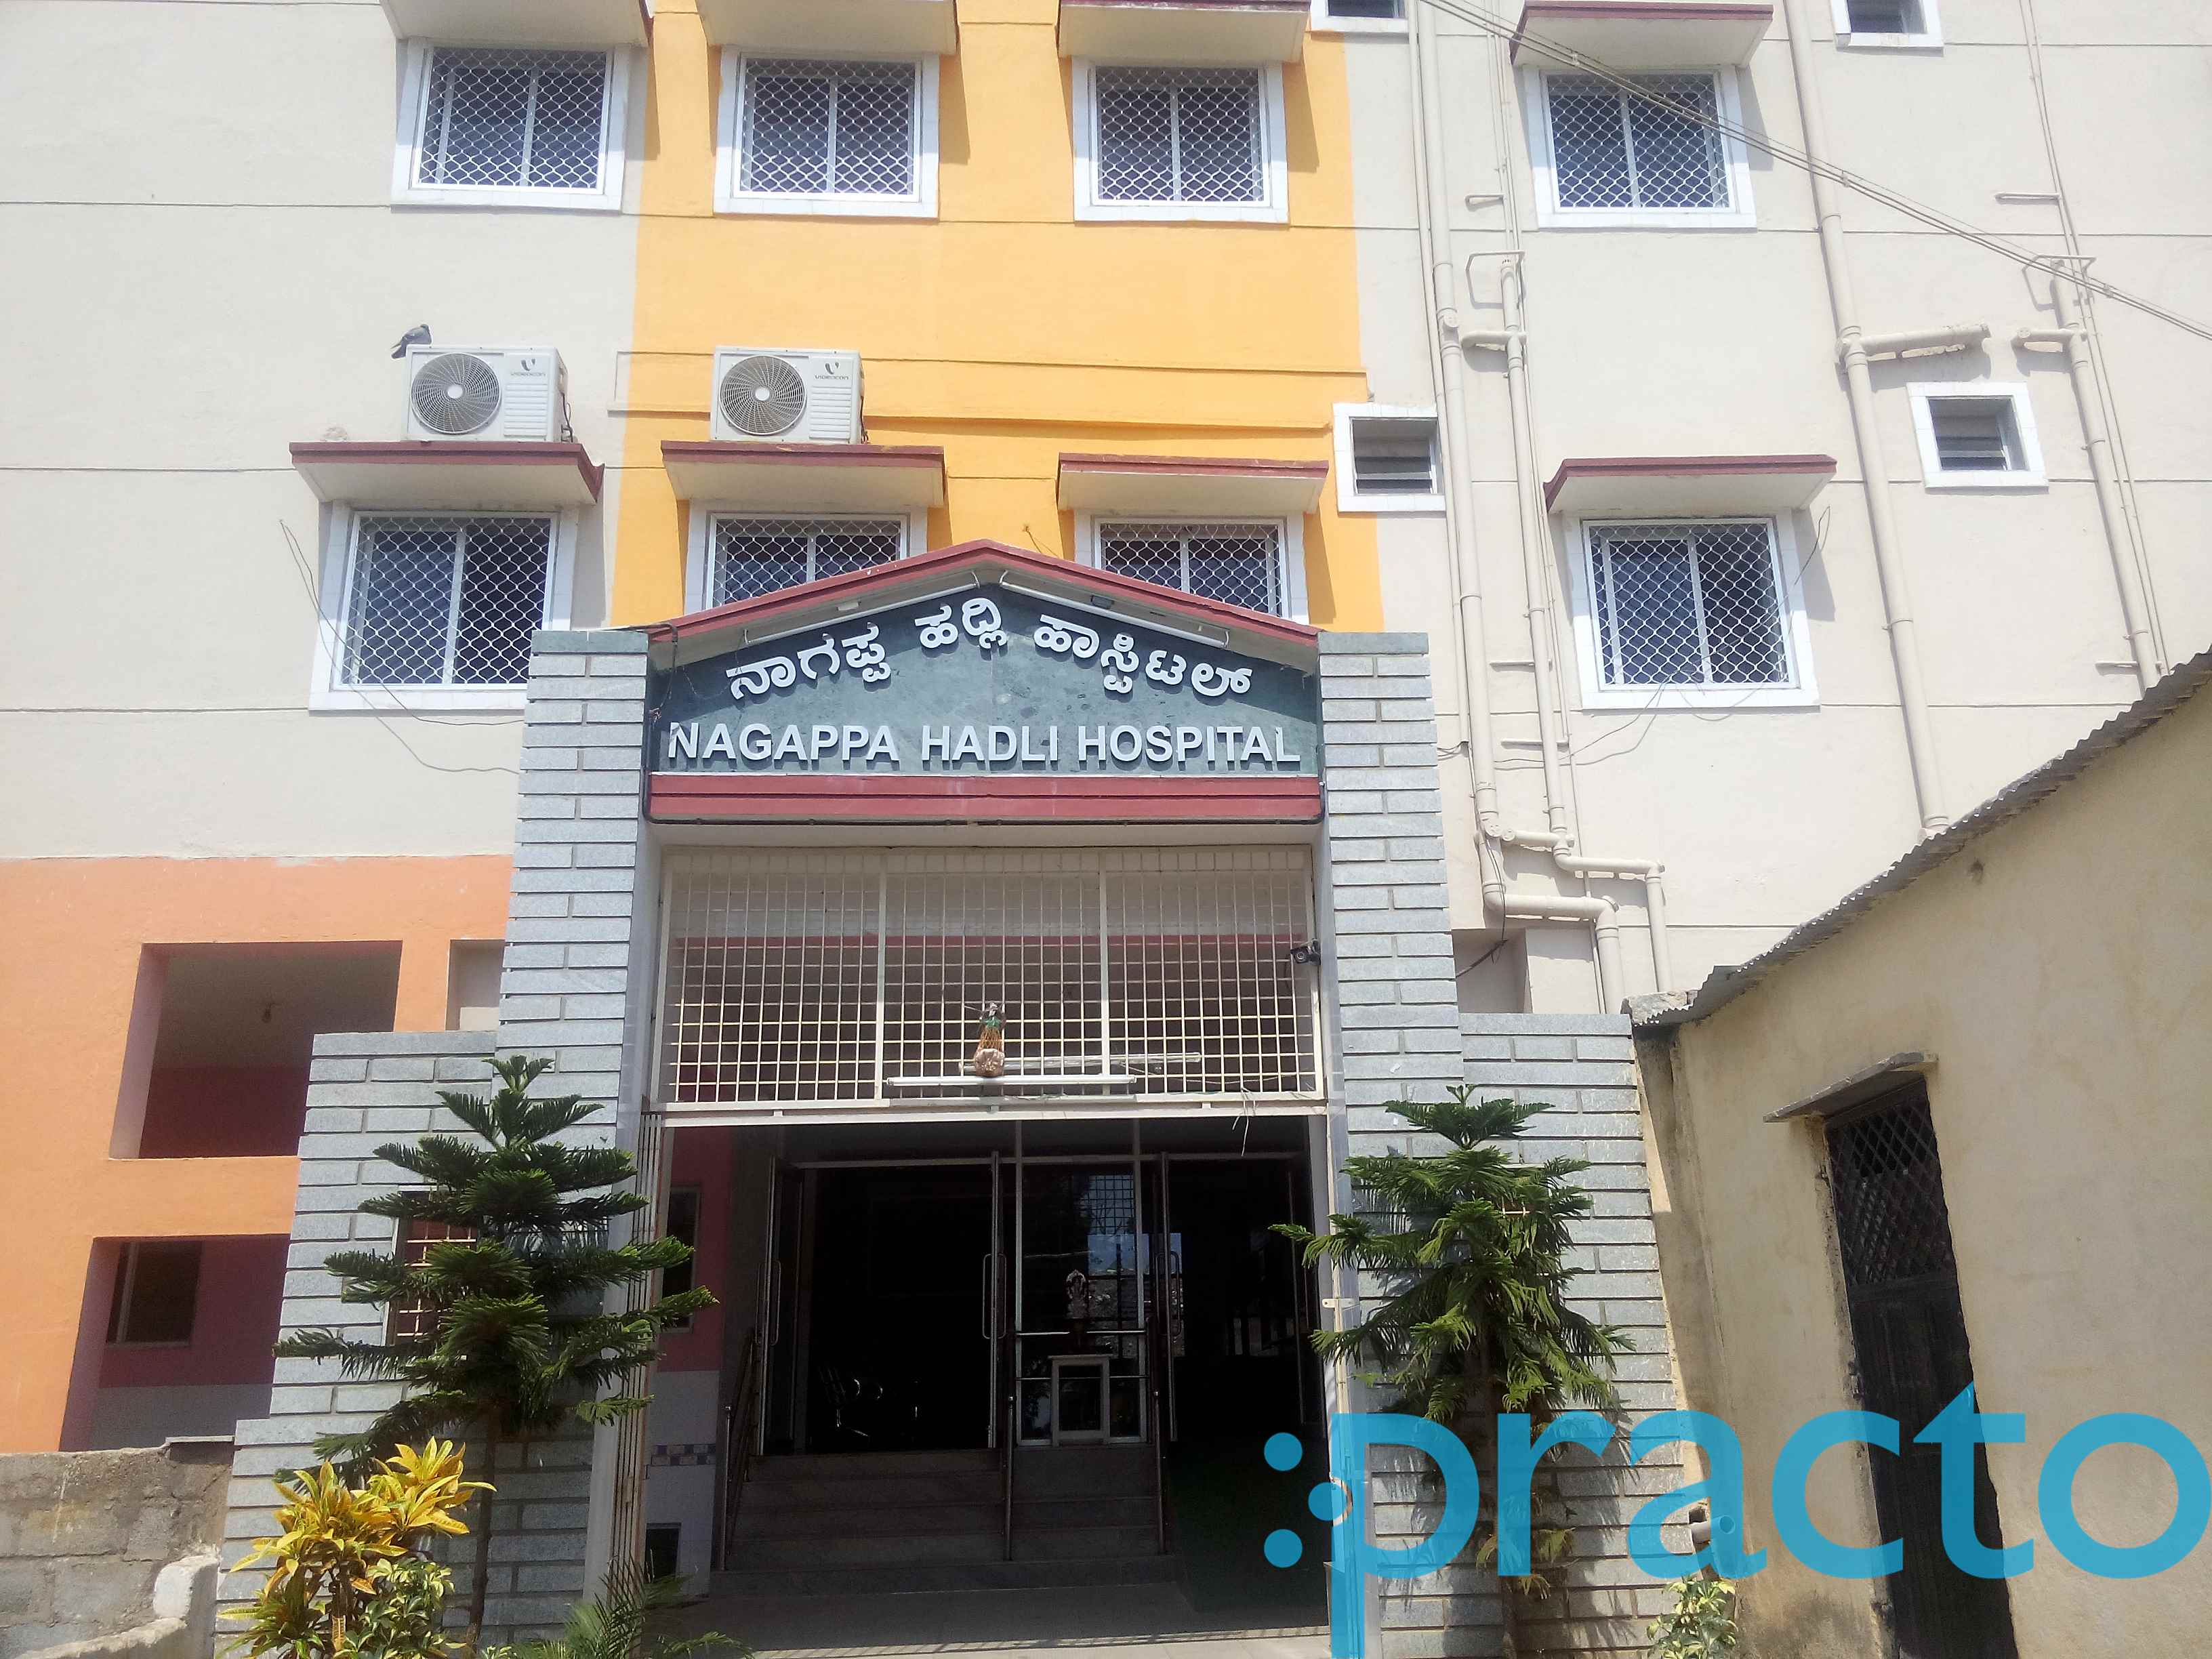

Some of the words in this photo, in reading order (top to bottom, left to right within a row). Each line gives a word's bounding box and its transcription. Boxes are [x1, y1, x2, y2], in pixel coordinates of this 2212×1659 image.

[725, 621, 892, 700] ನಾಗಪ್ಪ
[1033, 613, 1253, 697] ಹಾಸ್ಪಿಟಲ್
[667, 722, 900, 762] NAGAPPA
[921, 724, 1059, 762] HADLI
[1077, 724, 1301, 762] HOSPITAL
